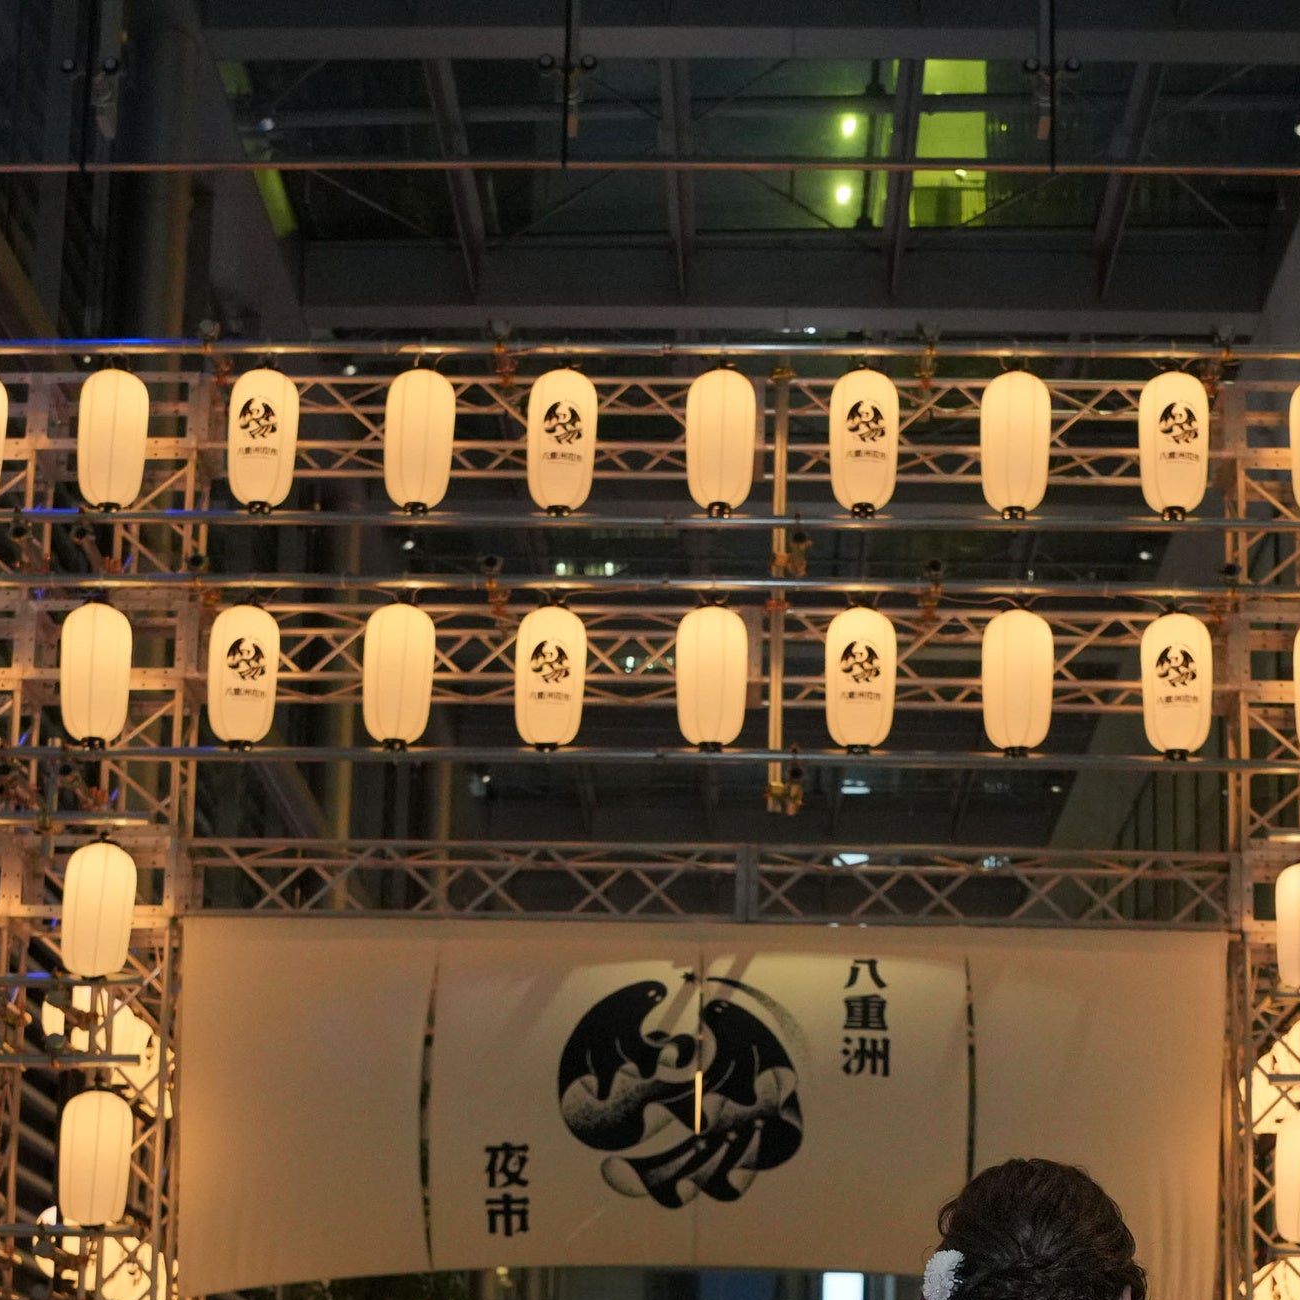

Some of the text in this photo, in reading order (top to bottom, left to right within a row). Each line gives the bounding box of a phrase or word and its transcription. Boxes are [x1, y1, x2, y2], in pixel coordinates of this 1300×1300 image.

[841, 957, 891, 1078] 八重洲
[484, 1142, 530, 1239] 夜市
